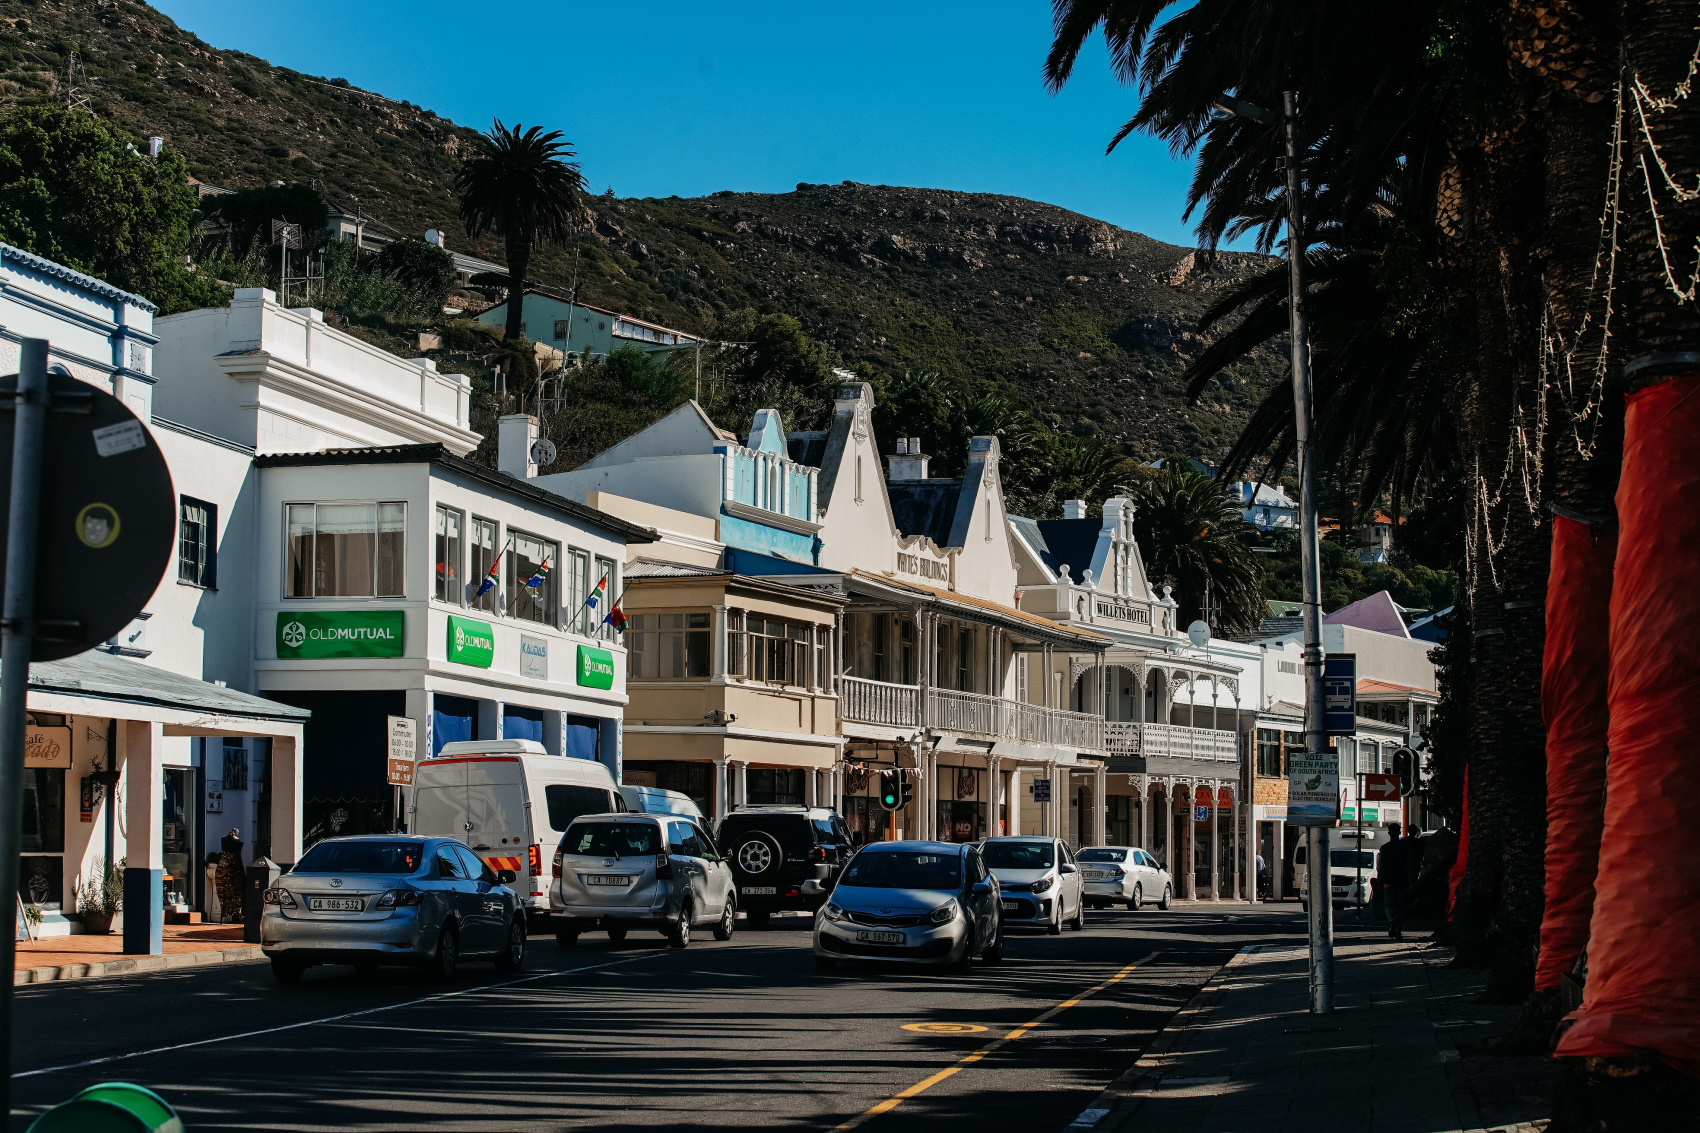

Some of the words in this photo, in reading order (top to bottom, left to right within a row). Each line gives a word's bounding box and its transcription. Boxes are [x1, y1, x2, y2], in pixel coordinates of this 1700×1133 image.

[1097, 602, 1126, 619] WILLETS
[1127, 608, 1149, 623] HOTEL
[956, 822, 971, 832] NO
[313, 899, 323, 909] CA
[327, 900, 359, 910] 986-532
[861, 932, 869, 940] CA
